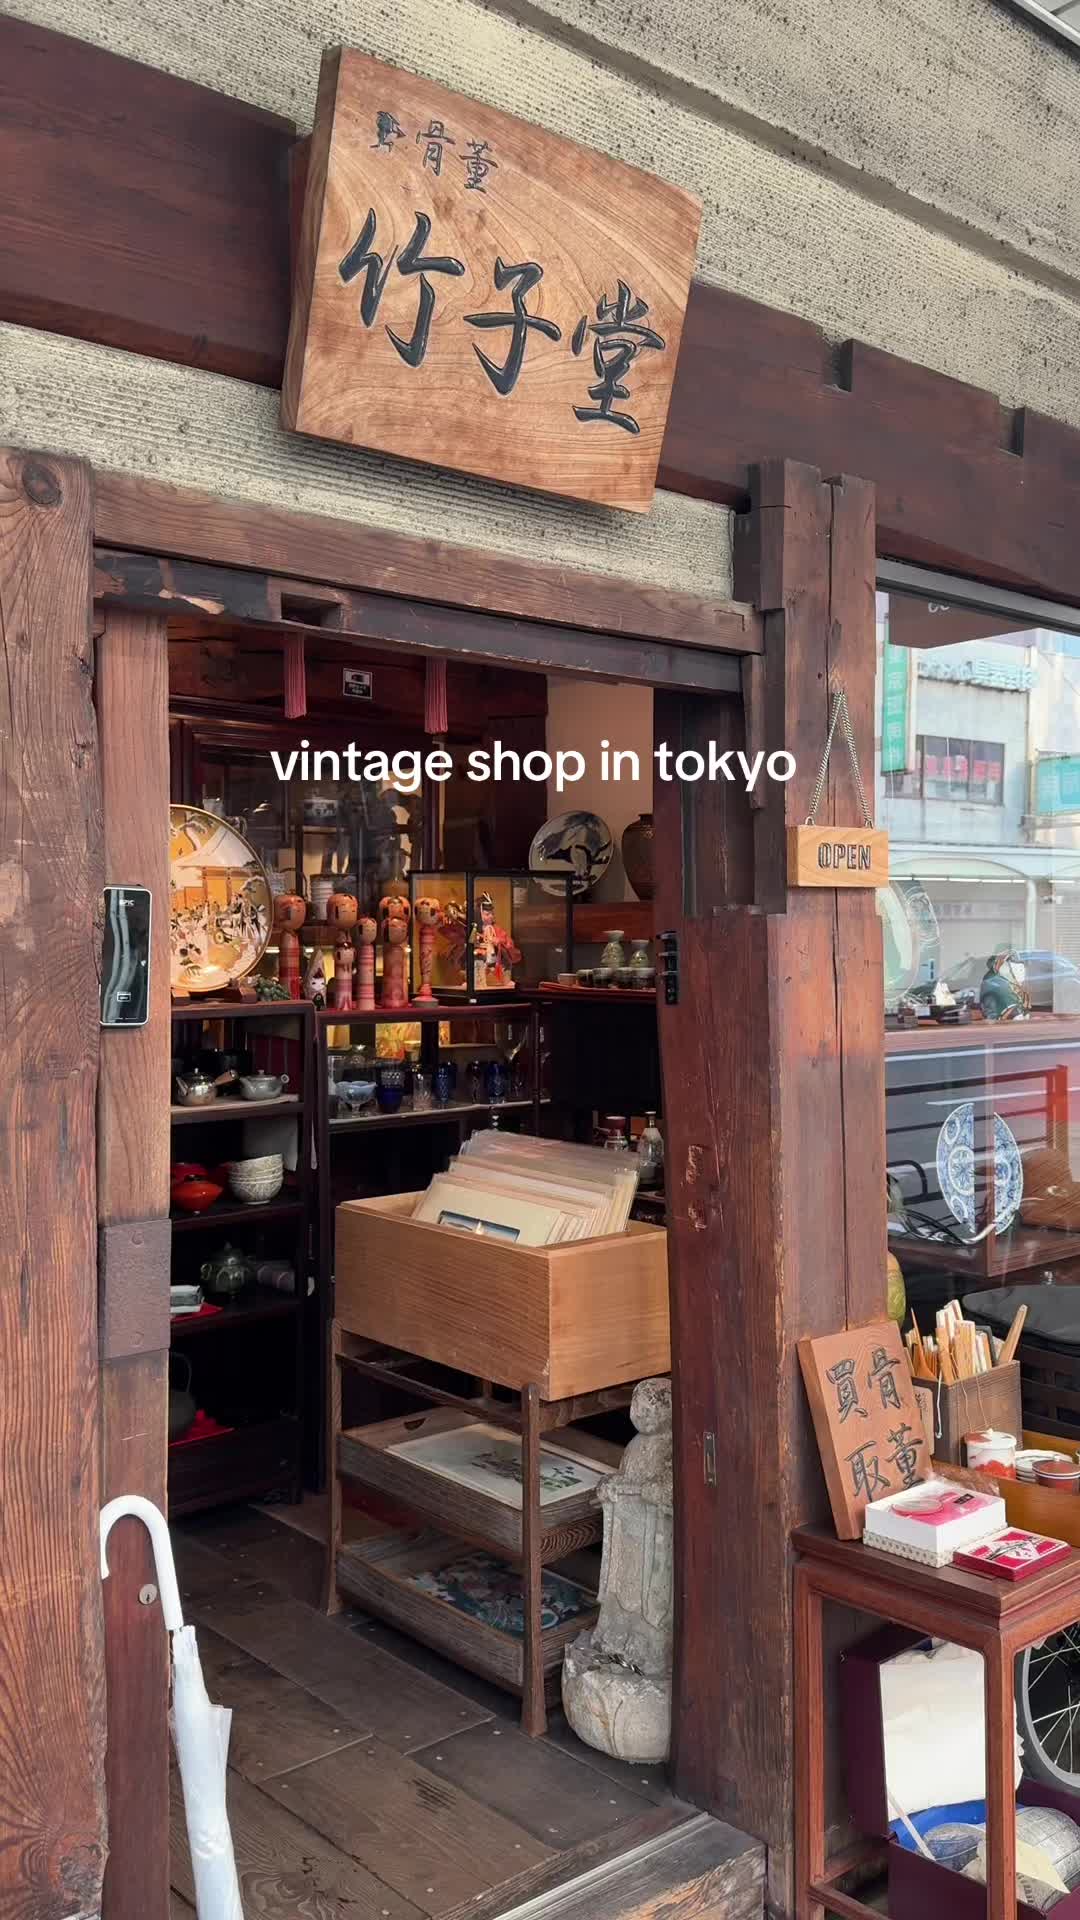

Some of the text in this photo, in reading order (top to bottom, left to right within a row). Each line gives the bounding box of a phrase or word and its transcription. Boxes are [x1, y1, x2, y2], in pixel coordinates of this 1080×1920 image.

[338, 207, 666, 434] 竹子堂
[818, 842, 872, 870] OPEN
